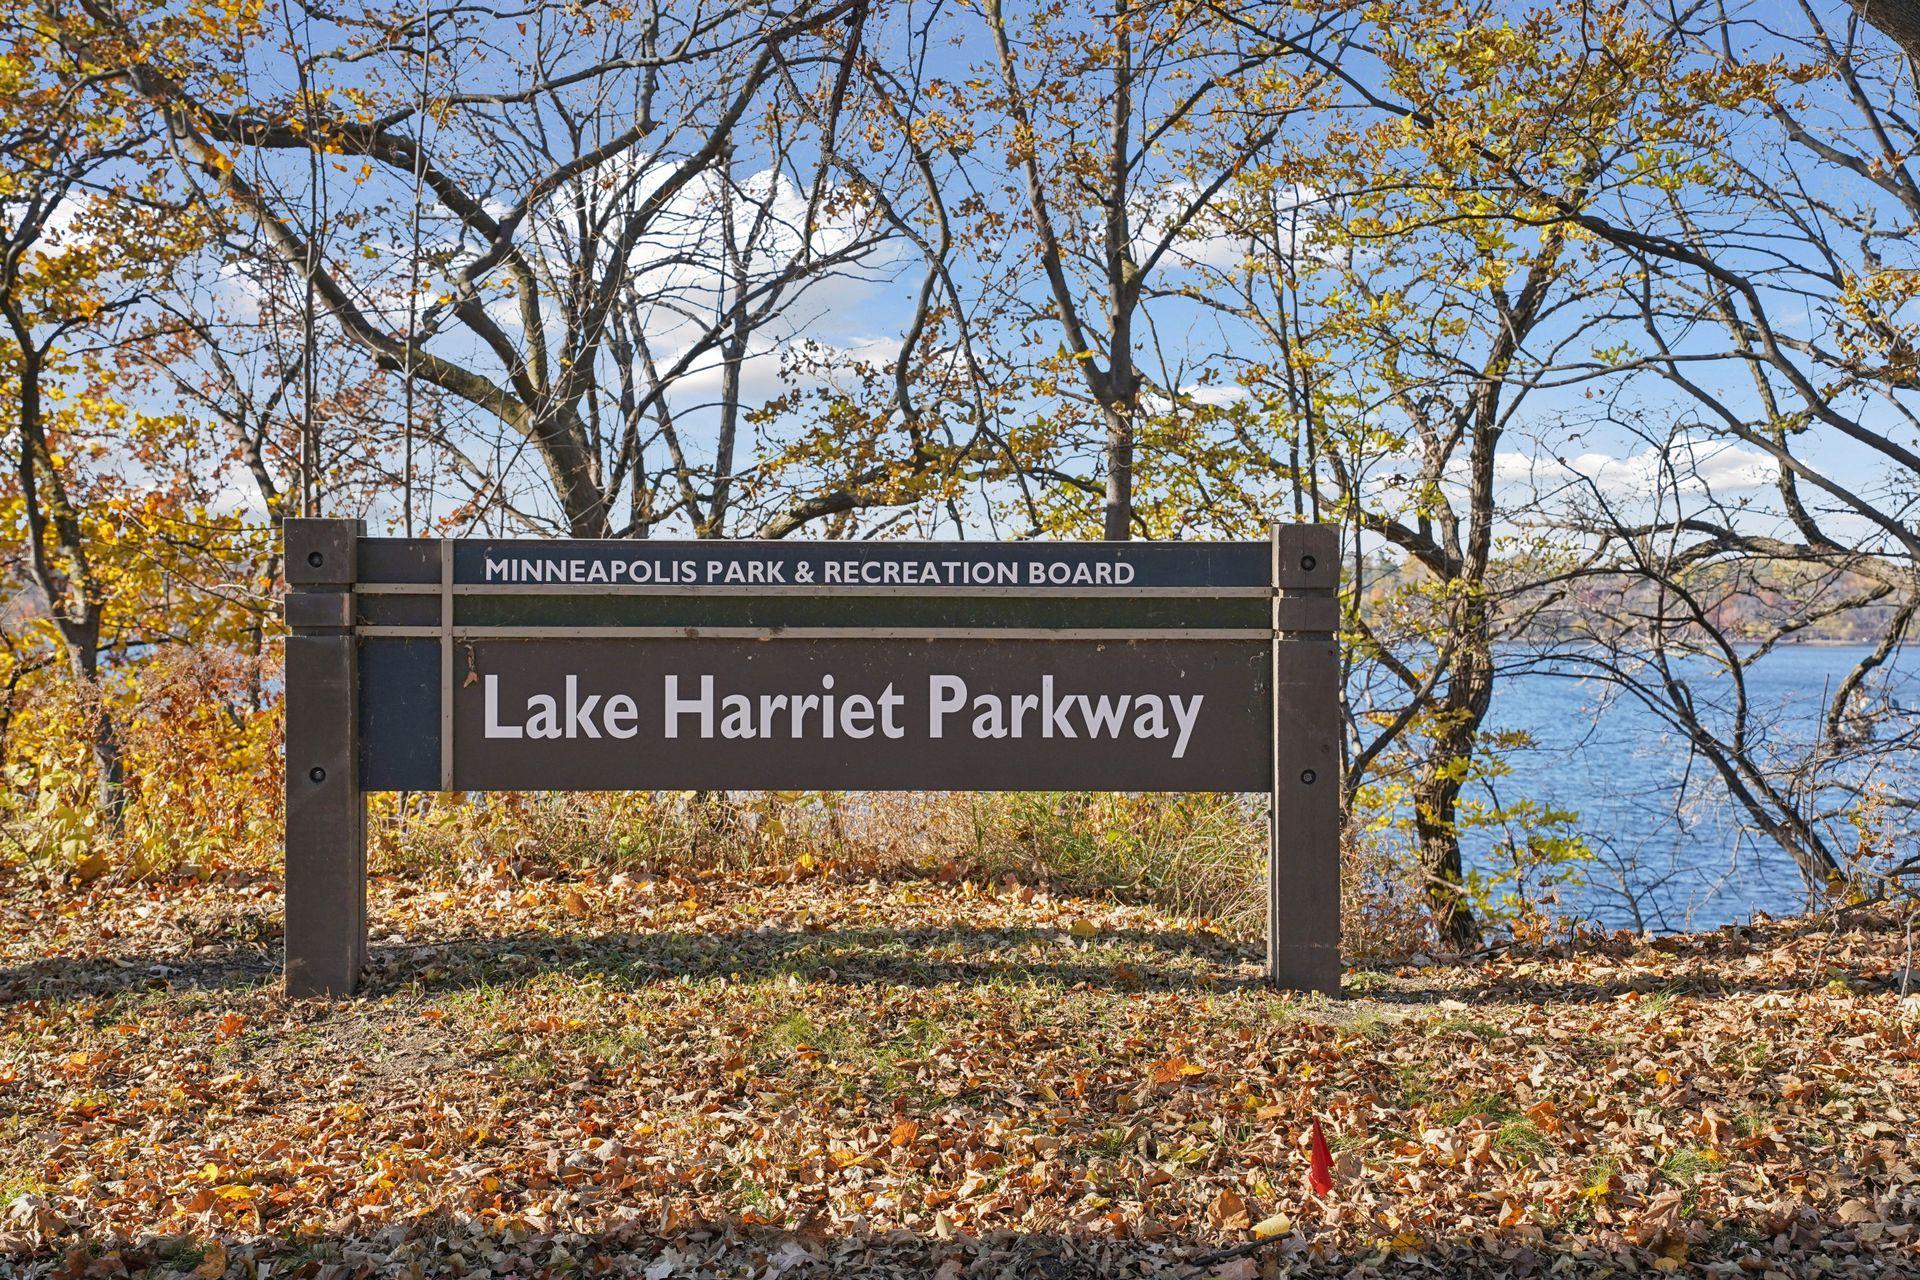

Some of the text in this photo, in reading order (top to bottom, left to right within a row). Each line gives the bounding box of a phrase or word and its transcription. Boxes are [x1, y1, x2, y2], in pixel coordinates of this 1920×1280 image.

[484, 558, 1136, 585] MINNEAPOLIS PARK & RECREATION BOARD
[483, 673, 1205, 759] Lake Harriet Parkway
